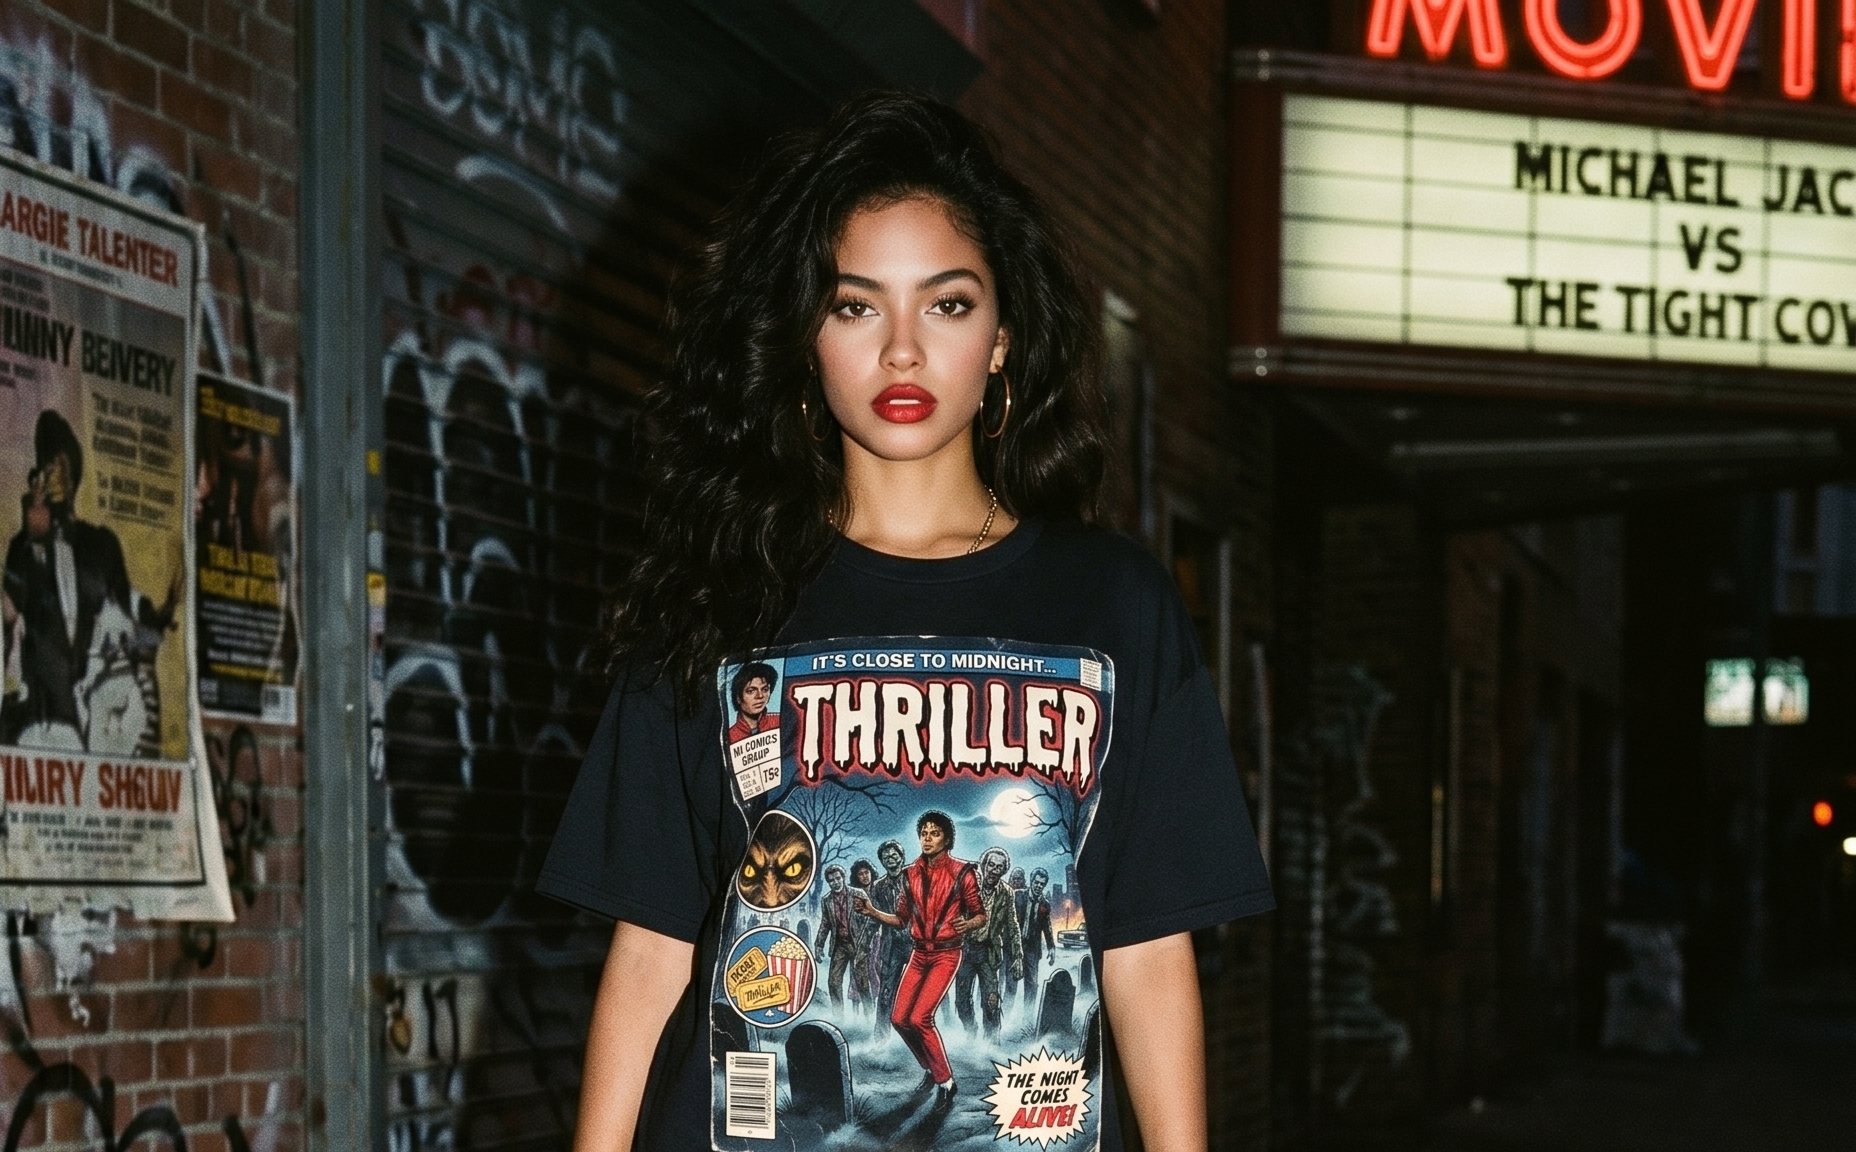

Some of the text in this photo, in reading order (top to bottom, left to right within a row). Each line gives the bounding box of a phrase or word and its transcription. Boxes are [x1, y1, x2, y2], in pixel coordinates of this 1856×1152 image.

[1366, 0, 1856, 104] MOVI
[1514, 141, 1856, 217] MICHAEL JAC
[1680, 223, 1742, 274] VS
[1506, 277, 1600, 330] THE
[1615, 285, 1759, 341] TIGHT
[812, 653, 1057, 673] IT'S CLOSE TO MIDNIGHT...
[792, 680, 1098, 790] THRILLER
[1007, 1069, 1079, 1088] THE NIGHT
[1020, 1087, 1070, 1105] COMES
